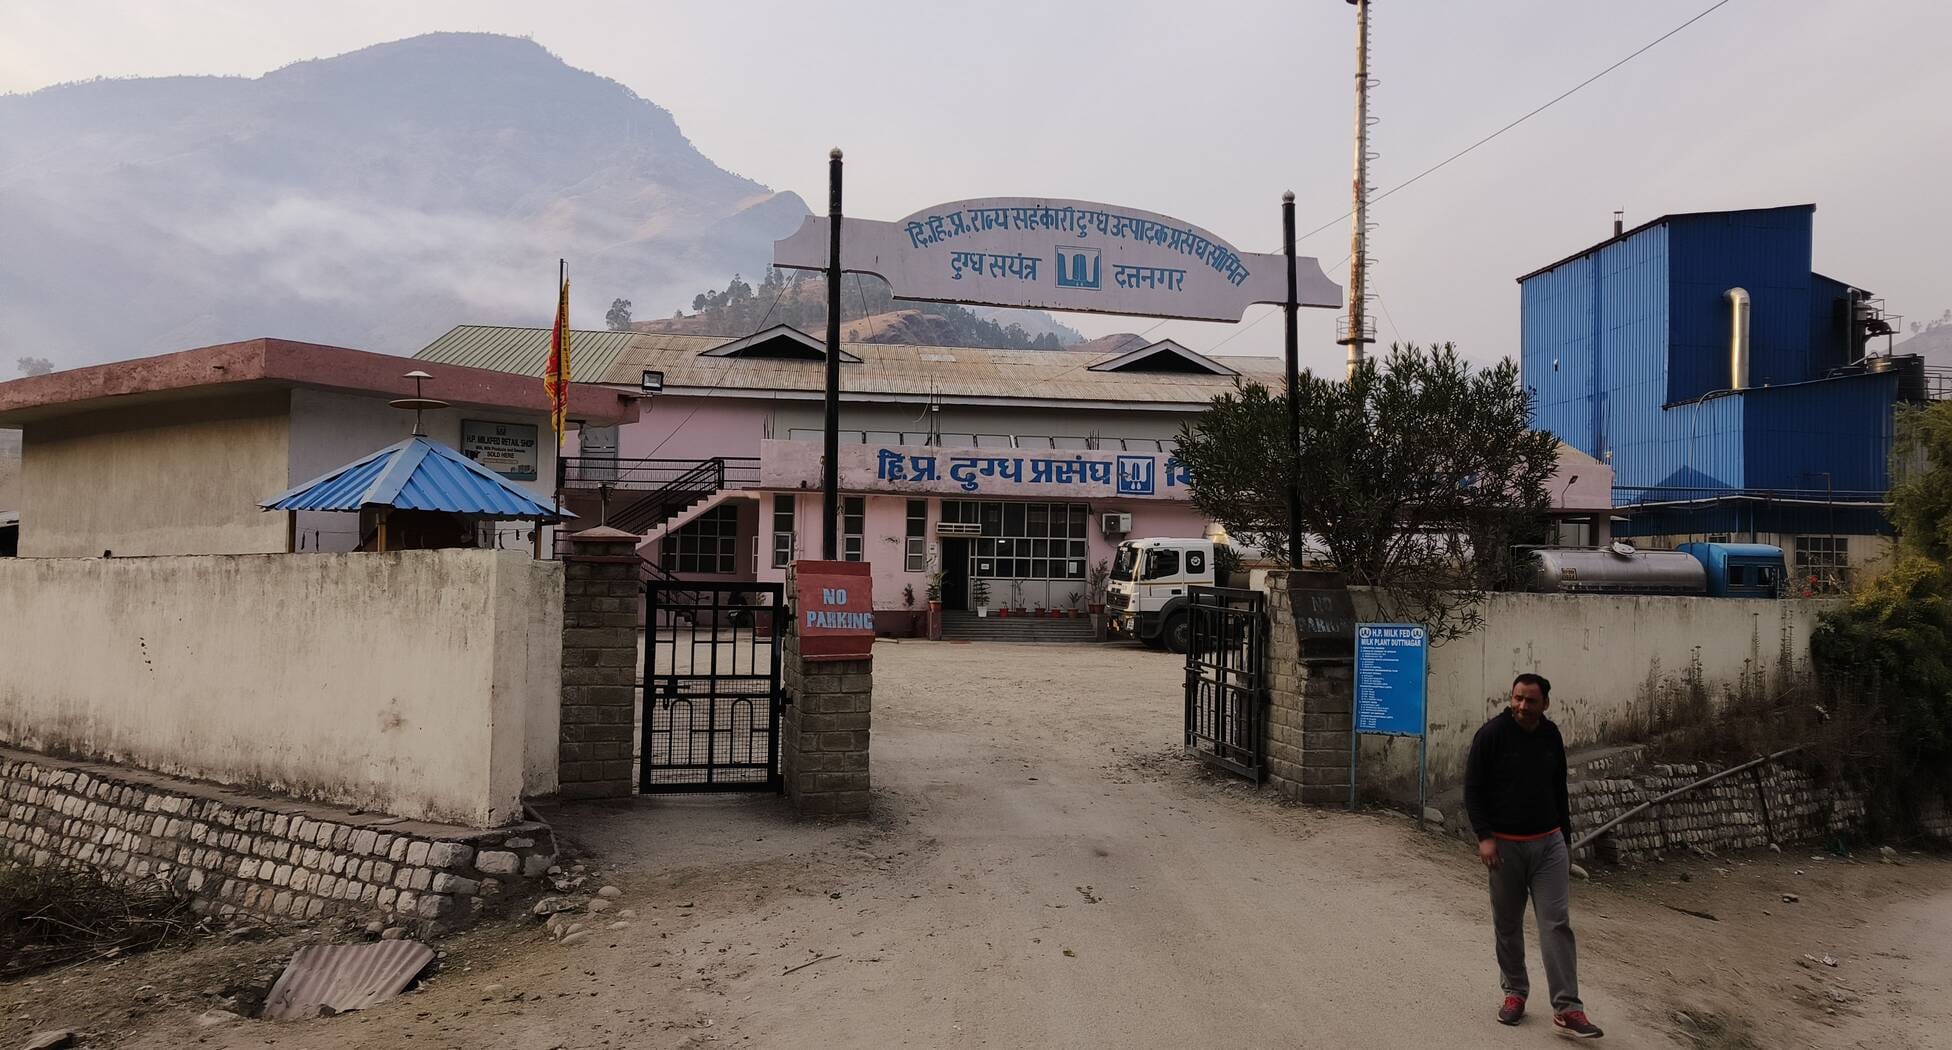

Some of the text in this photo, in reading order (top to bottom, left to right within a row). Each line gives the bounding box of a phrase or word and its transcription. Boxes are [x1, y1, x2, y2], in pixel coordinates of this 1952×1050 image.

[951, 252, 986, 280] दुग्ध
[1112, 264, 1187, 292] दत्तनगर
[520, 440, 534, 448] SHOP
[950, 457, 1023, 492] दुग्ध
[1029, 455, 1113, 485] प्रसंघ
[823, 588, 847, 605] NO
[806, 611, 874, 630] PARKING
[1361, 638, 1422, 647] MILK PLANT DUTTNAGAR
[1372, 629, 1411, 638] H.P. MILK FED
